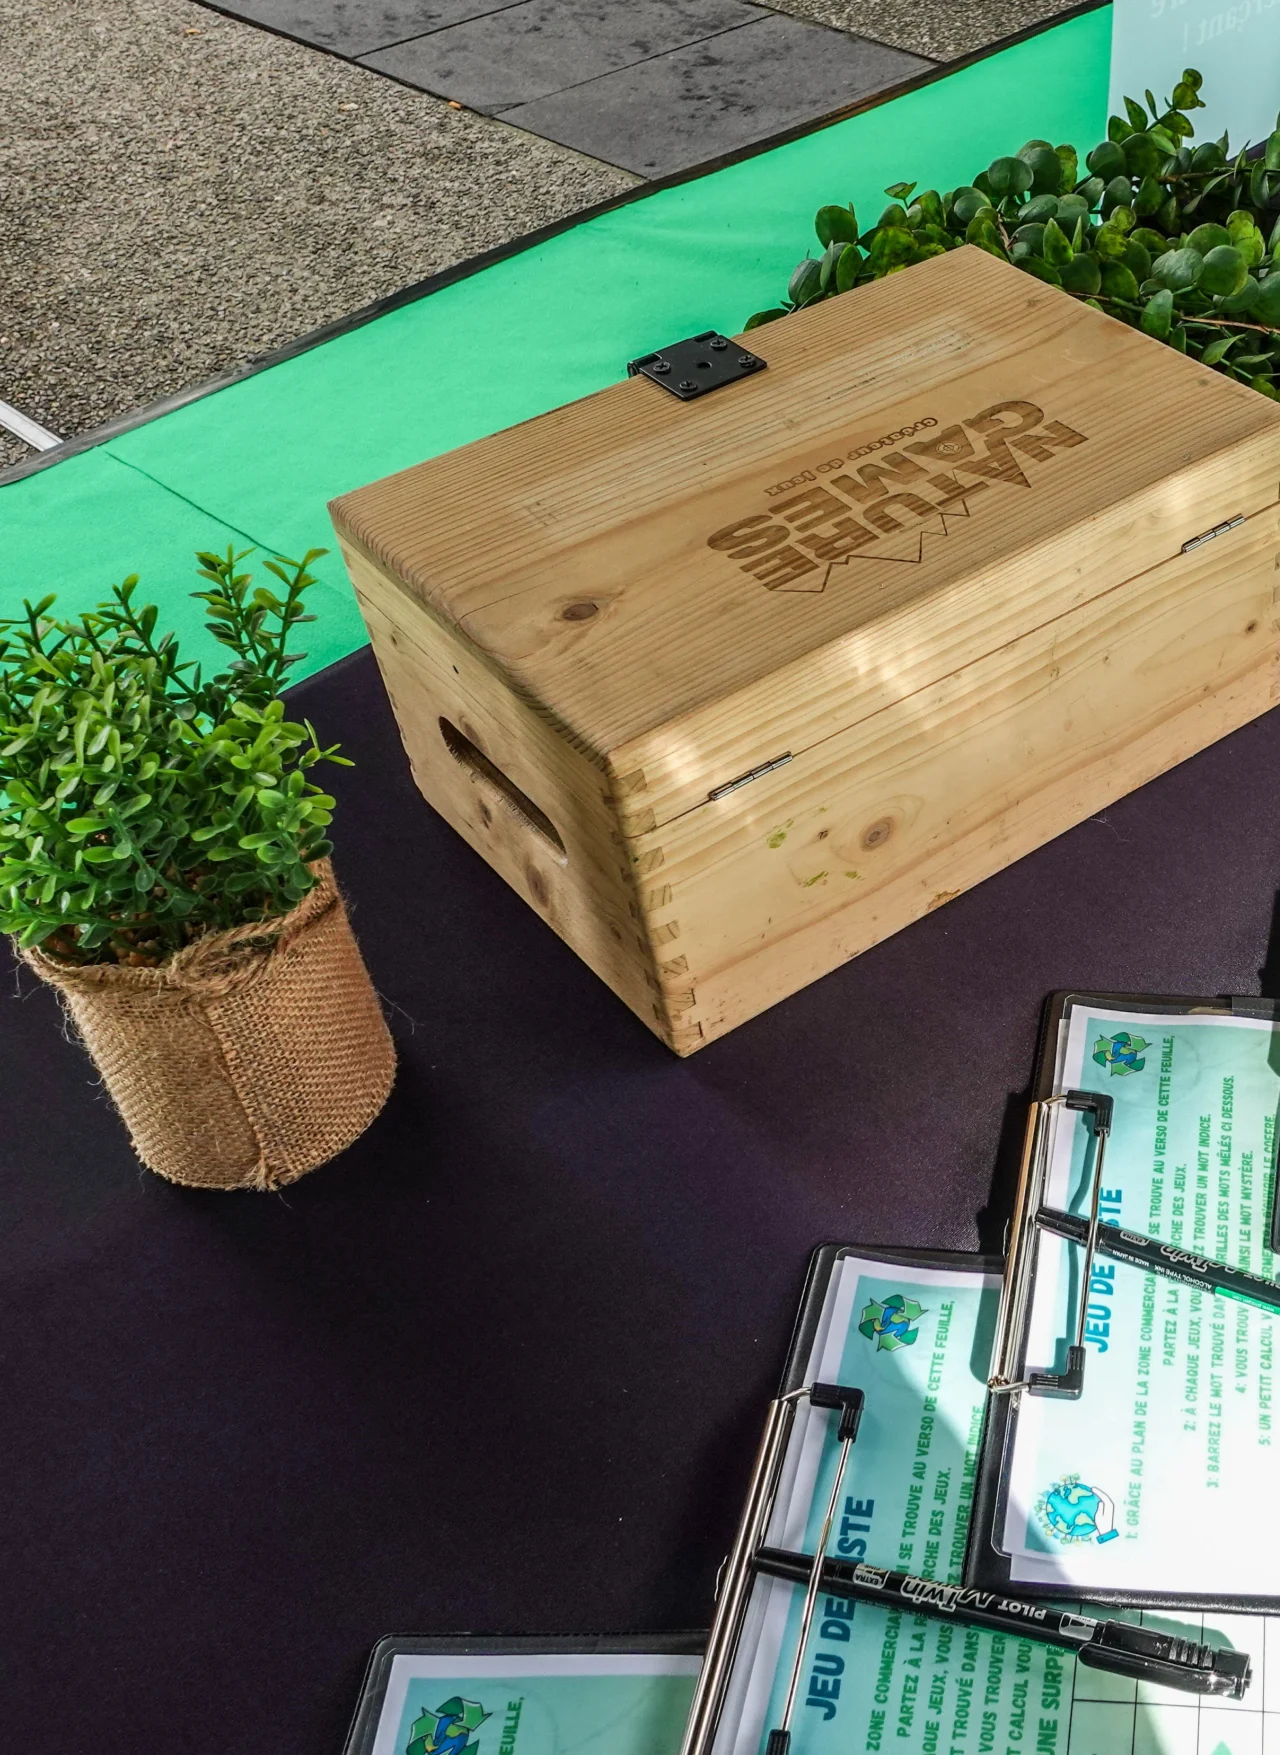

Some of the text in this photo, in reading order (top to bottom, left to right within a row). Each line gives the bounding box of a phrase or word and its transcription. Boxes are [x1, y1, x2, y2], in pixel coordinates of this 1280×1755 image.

[707, 400, 1044, 560] GAMES
[738, 420, 1089, 592] NATURE
[1148, 1035, 1175, 1235] SE TROUVE AU VERSO DE CETTE FEUILLE,
[1217, 1075, 1234, 1221] DES MOTS MÊLÉS CI DESSOUS.
[1173, 1164, 1187, 1216] DES JEUX.
[1193, 1114, 1211, 1241] TROUVER UN MOT INDICE.
[1237, 1150, 1253, 1272] AINSI LE MOT MYSTÈRE.
[1085, 1263, 1115, 1353] JEU DE
[1163, 1289, 1180, 1366] PARTEZ À LA
[1188, 1317, 1203, 1349] JEUX,
[1235, 1348, 1248, 1378] VOUS
[1260, 1325, 1273, 1370] CALCUL
[1185, 1354, 1200, 1402] CHAQUE
[1259, 1375, 1272, 1409] PETIT
[898, 1300, 954, 1560] SE TROUVE AU VERSO DE CETTE FEUILLE,
[1259, 1414, 1272, 1430] UN
[929, 1467, 951, 1536] DES JEUX.
[854, 1572, 880, 1585] EXTRA
[900, 1575, 957, 1613] Twin
[997, 1599, 1047, 1620] PILOT
[805, 1597, 855, 1721] JEU DE
[502, 1696, 525, 1755] EUILLE,
[866, 1710, 885, 1751] ZONE
